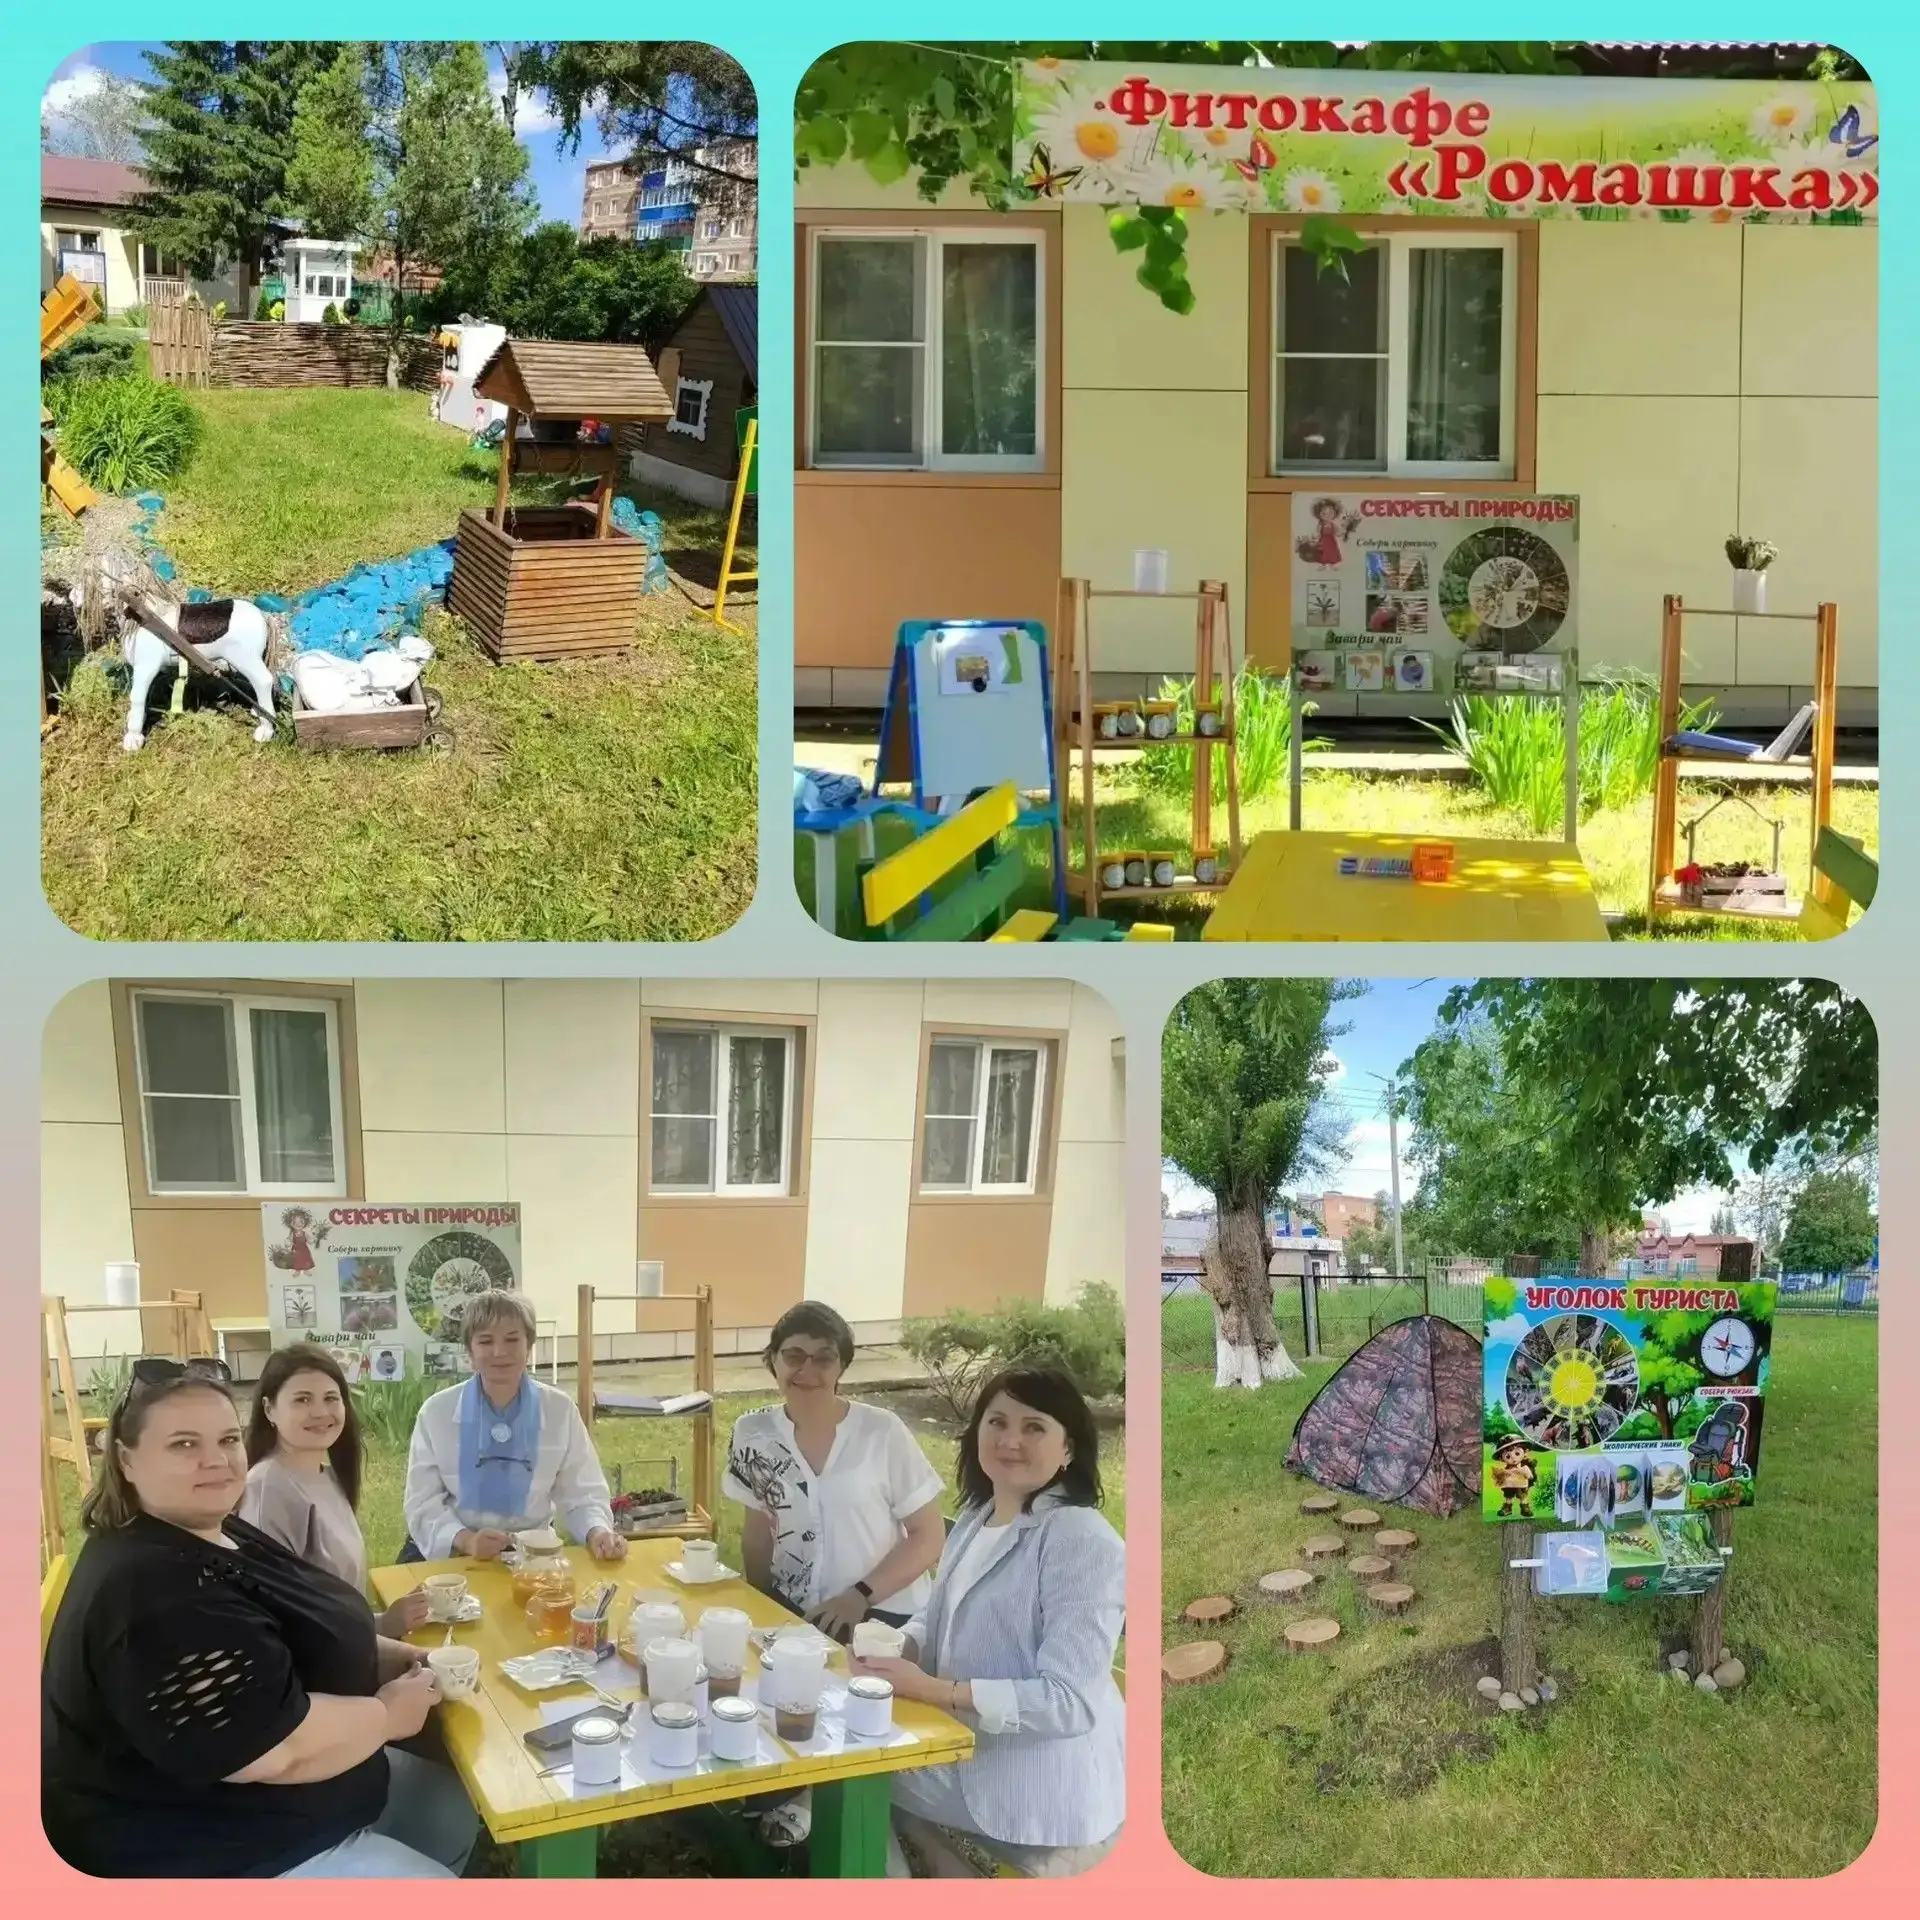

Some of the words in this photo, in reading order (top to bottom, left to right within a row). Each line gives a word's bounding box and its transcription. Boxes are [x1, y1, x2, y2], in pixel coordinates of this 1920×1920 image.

[1109, 77, 1490, 146] Фитокафе
[1387, 143, 1878, 209] «Ромашка»
[1361, 500, 1459, 518] СЕКРЕТЫ
[1465, 500, 1574, 521] ПРИРОДЫ
[328, 1208, 420, 1225] СЕКРЕТЫ
[424, 1208, 516, 1226] ПРИРОДЫ
[1526, 1286, 1628, 1310] УГОЛОК
[1633, 1288, 1740, 1311] ТУРИСТА
[1602, 1442, 1658, 1450] ЭКОЛОГИЧЕСКИЕ
